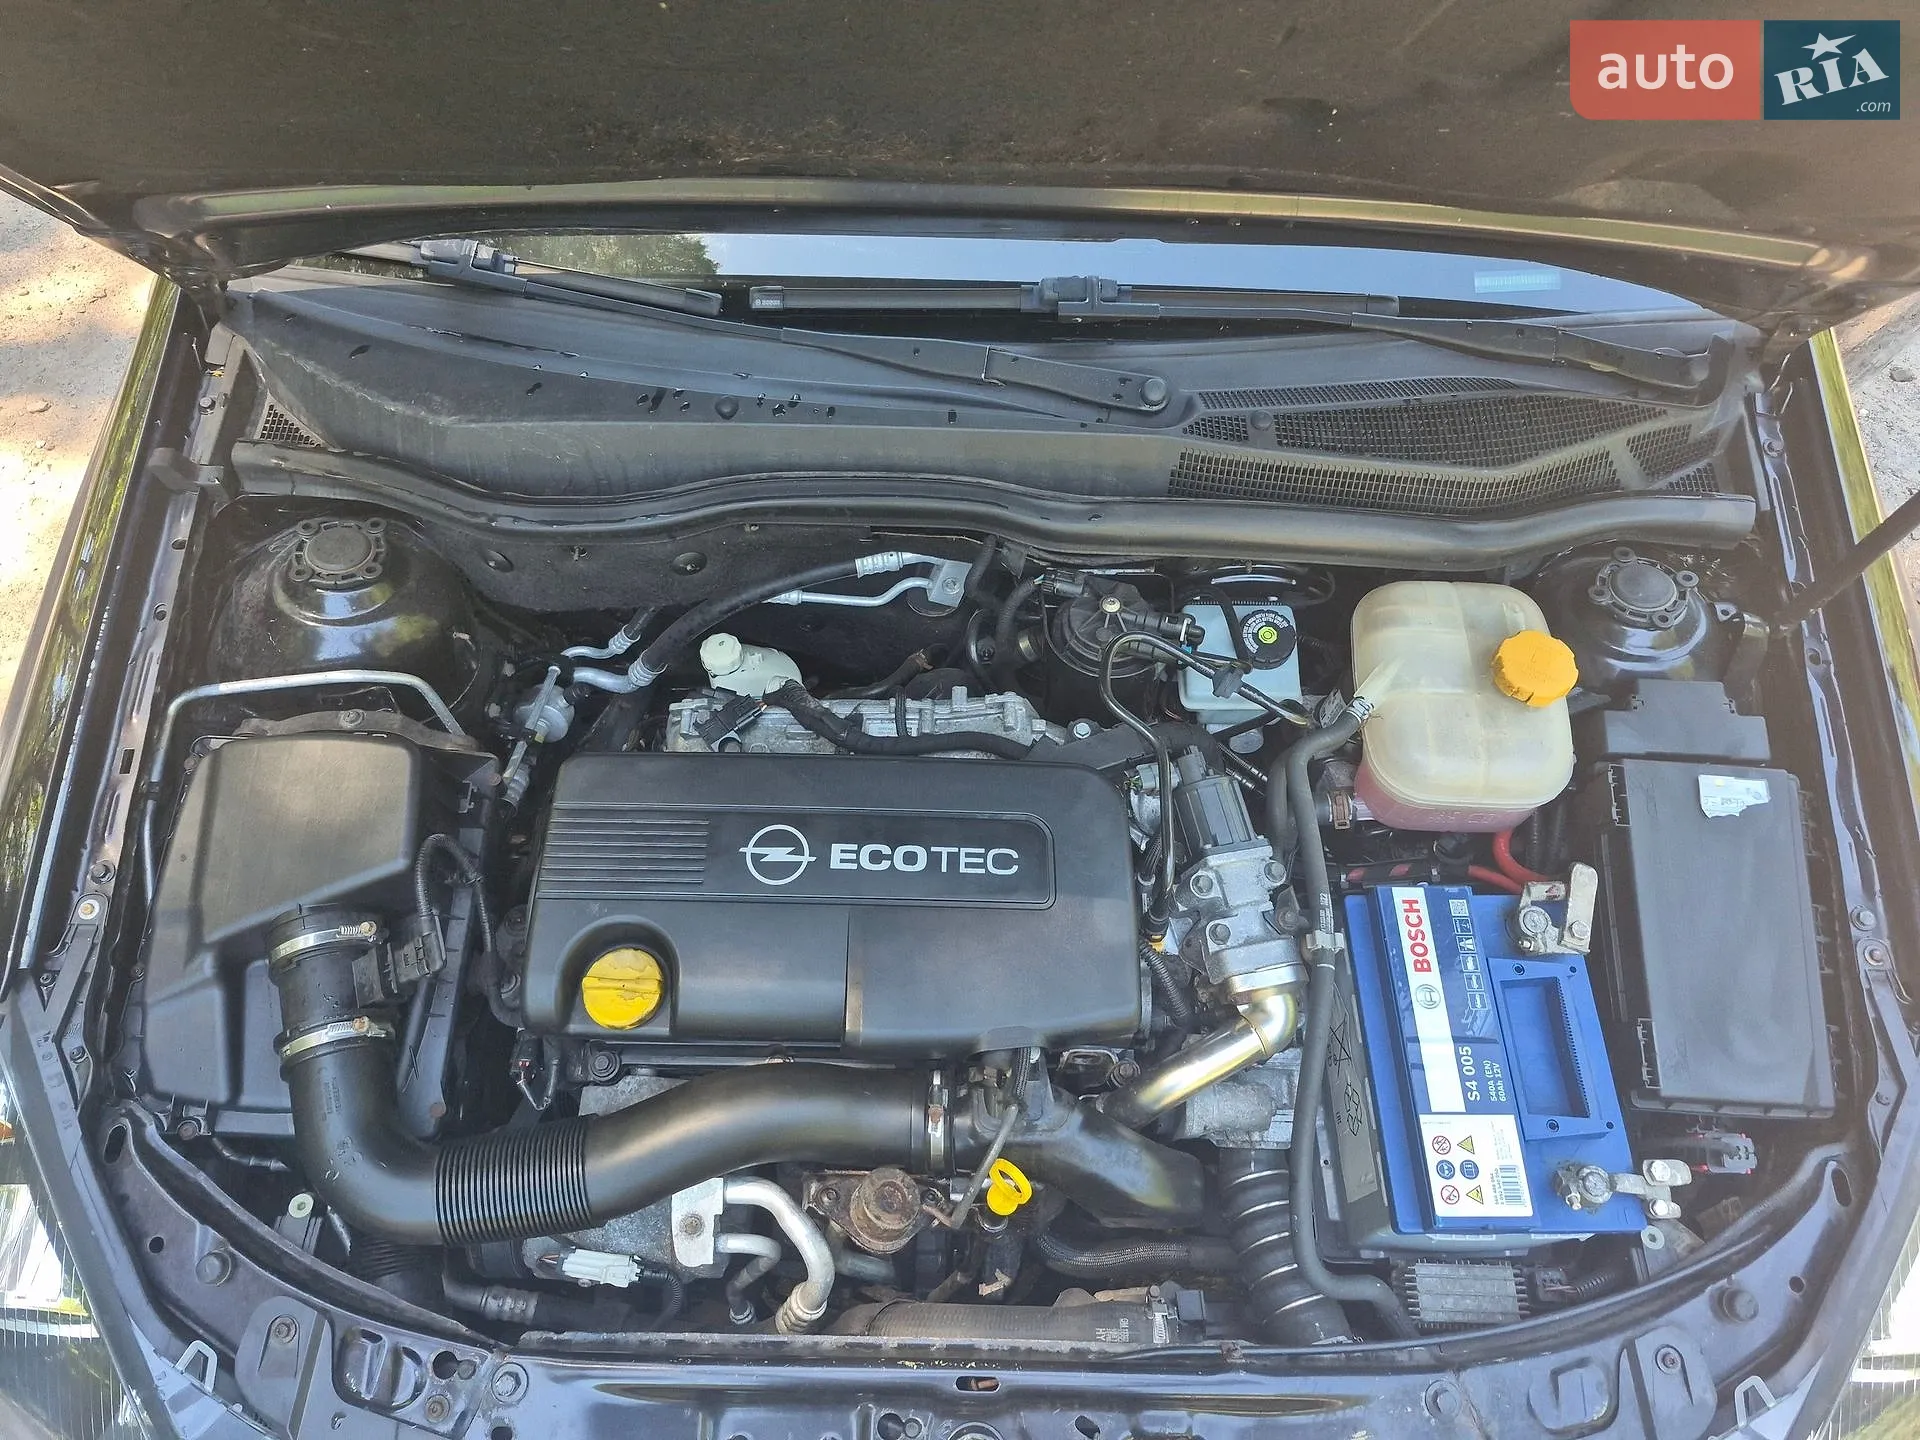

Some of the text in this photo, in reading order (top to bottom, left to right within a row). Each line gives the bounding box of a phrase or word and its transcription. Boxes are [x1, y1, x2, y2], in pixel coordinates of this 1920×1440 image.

[829, 843, 1019, 875] ECOTEC
[1401, 899, 1432, 973] BOSCH
[1458, 1046, 1480, 1101] S4 005
[1482, 1060, 1498, 1101] 540A (EN)
[1492, 1062, 1507, 1101] 60Ah 12V
